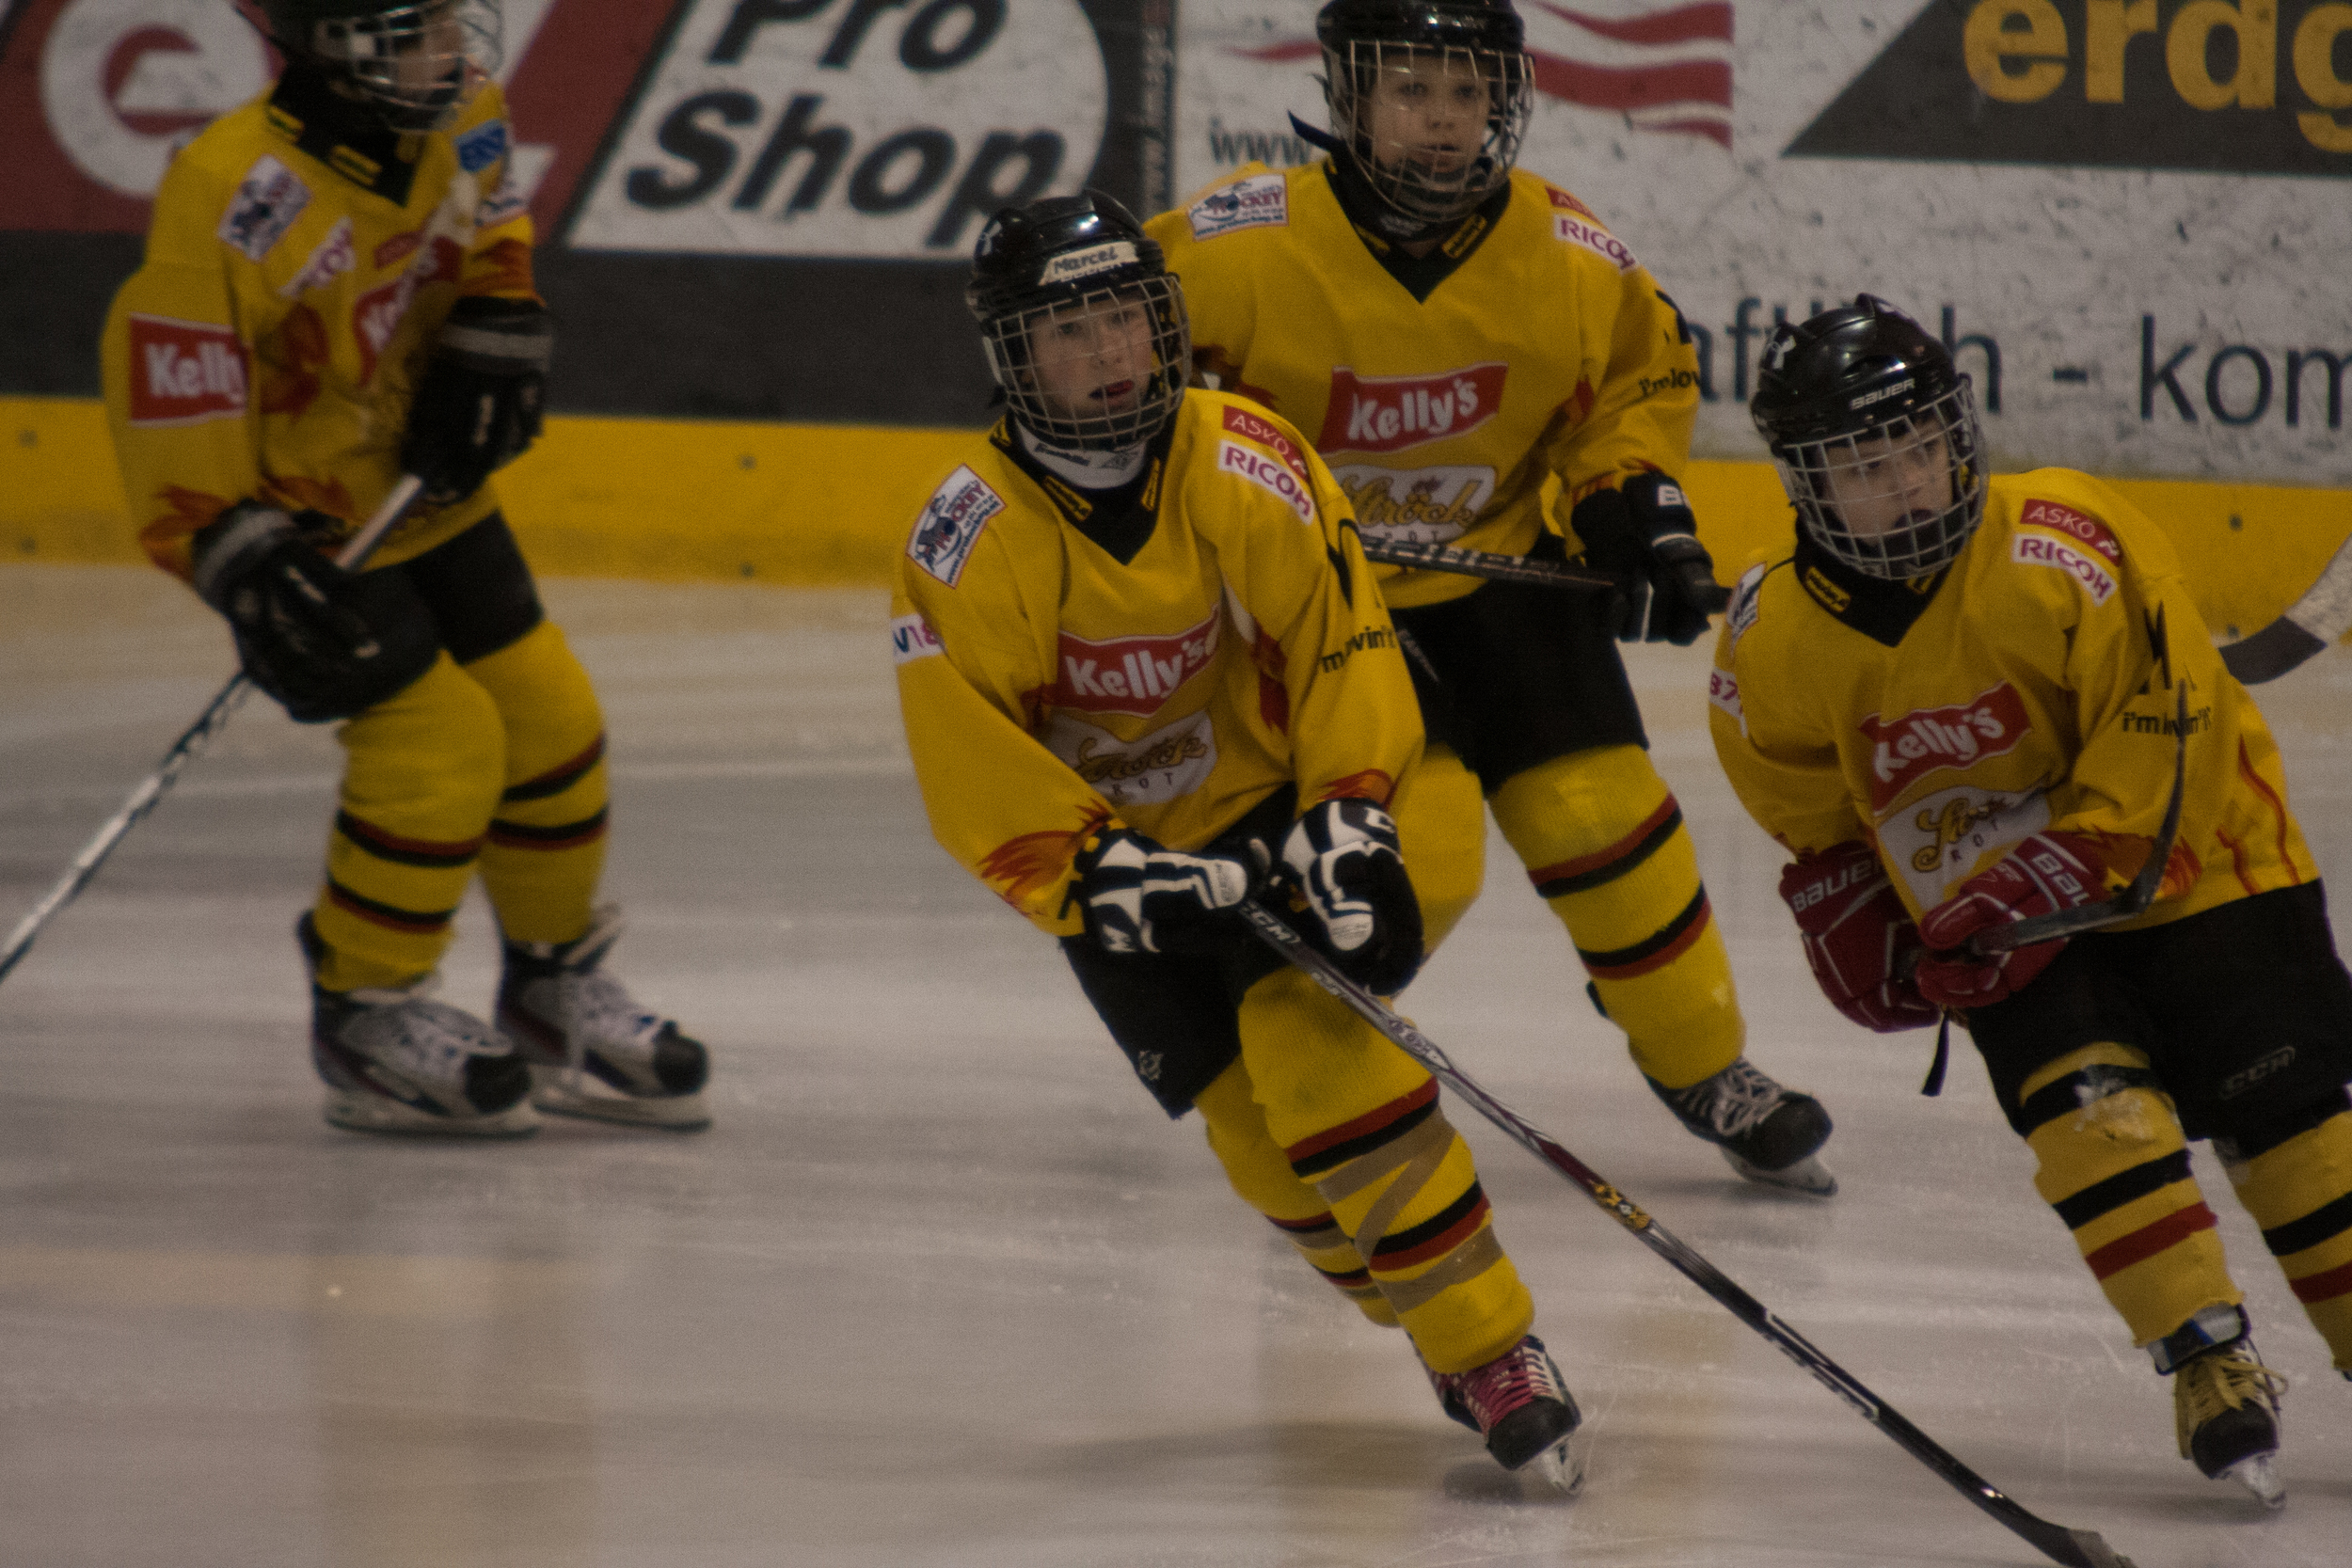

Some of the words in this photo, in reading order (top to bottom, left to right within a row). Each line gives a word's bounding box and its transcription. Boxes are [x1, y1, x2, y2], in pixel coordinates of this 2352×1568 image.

[626, 90, 1065, 247] Shop
[1561, 219, 1635, 270] RICOH
[1346, 378, 1480, 441] Kelly's
[2020, 538, 2111, 598] RICOH
[1064, 637, 1205, 700] Kelly's
[1873, 706, 2007, 784] Kelly's
